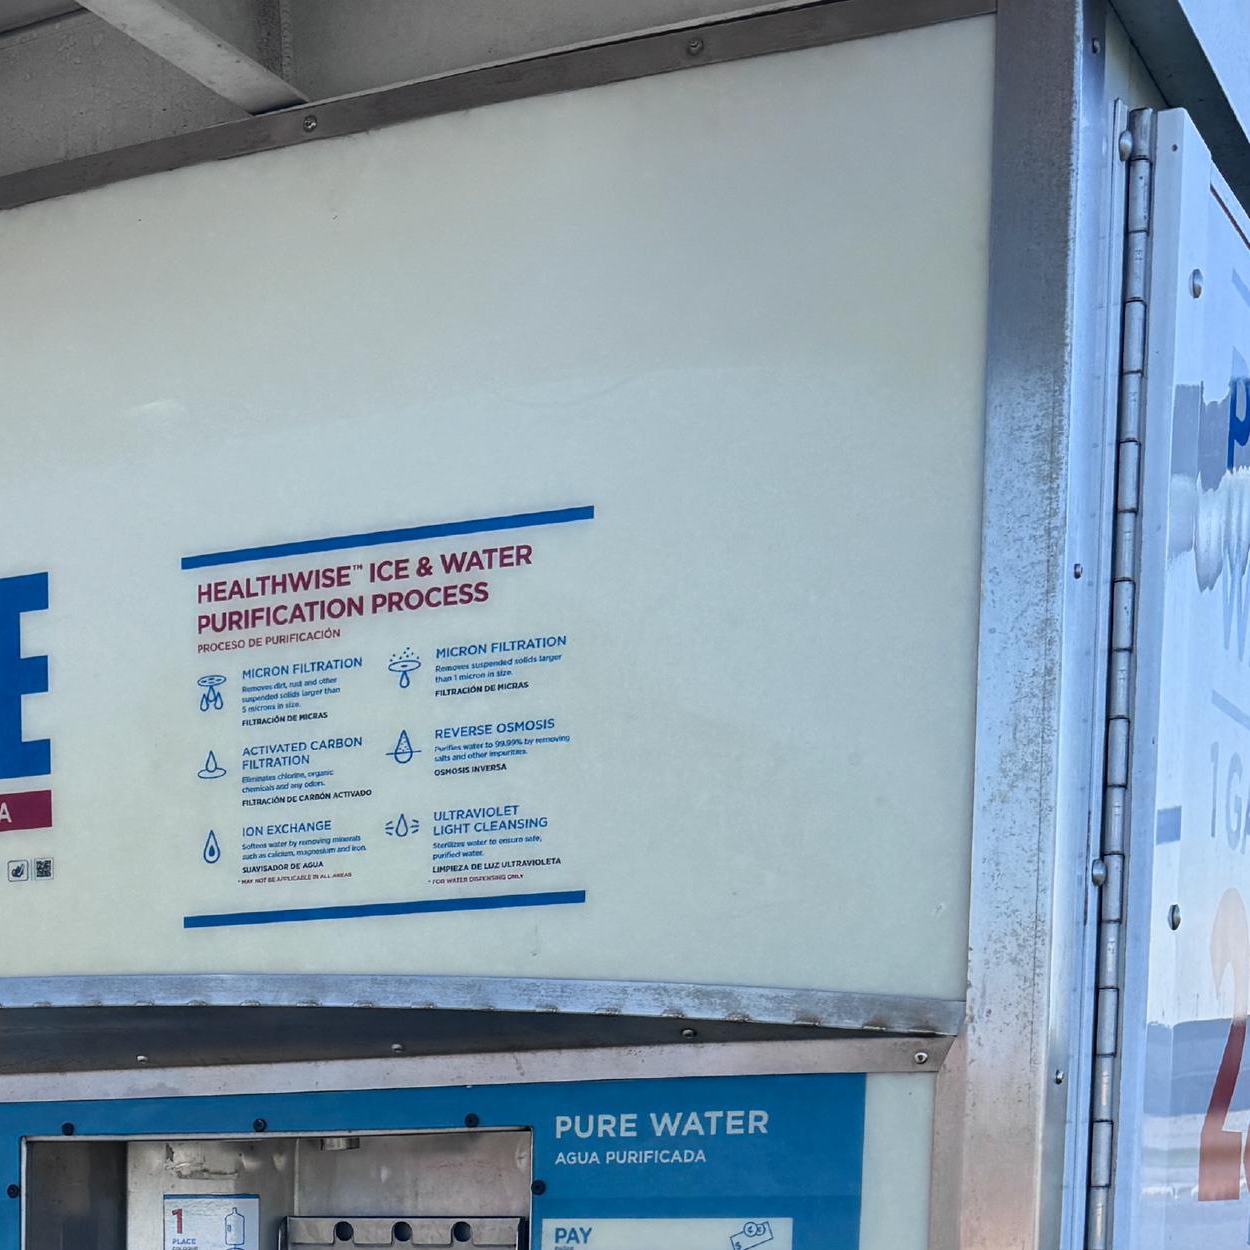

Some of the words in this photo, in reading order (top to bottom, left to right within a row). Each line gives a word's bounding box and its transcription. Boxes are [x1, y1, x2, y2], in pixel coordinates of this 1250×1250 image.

[369, 559, 409, 584] ICE
[416, 556, 433, 577] &
[441, 545, 533, 574] WATER
[198, 596, 364, 634] PURIFICATION
[371, 582, 489, 614] PROCESS
[198, 640, 245, 653] PROCESO
[249, 639, 262, 647] DE
[265, 628, 341, 645] PURIFICACIÓN
[436, 644, 487, 659] MICRON
[491, 636, 566, 653] FILTRATION
[242, 665, 288, 679] MICRON
[293, 657, 362, 674] FILTRATION
[435, 664, 469, 672] Removes
[472, 659, 512, 669] suspended
[515, 656, 537, 664] solids
[539, 654, 562, 663] larger
[435, 675, 451, 683] than
[459, 672, 485, 680] micron
[242, 685, 272, 693] Removes
[289, 680, 302, 688] rust
[435, 686, 482, 697] FILTRACIÓN
[498, 682, 529, 690] MICRAS
[242, 693, 278, 703] suspended
[302, 689, 322, 697] larger
[248, 704, 275, 712] microns
[242, 716, 285, 726] FILTRACIÓN
[299, 712, 328, 720] MICRAS
[435, 724, 492, 739] REVERSE
[497, 719, 555, 733] OSMOSIS
[242, 742, 306, 756] ACTIVATED
[310, 737, 362, 750] CARBON
[242, 755, 309, 770] FILTRATION
[435, 754, 450, 762] salts
[467, 751, 487, 759] other
[489, 749, 527, 757] impurities.
[434, 766, 469, 776] OSMOSIS
[472, 764, 507, 772] INVERSA
[242, 784, 274, 793] chemicals
[291, 782, 303, 790] any
[305, 780, 325, 788] odors.
[242, 796, 285, 806] FILTRACIÓN
[299, 791, 330, 802] CARBÓN
[333, 790, 372, 799] ACTIVADO
[434, 805, 519, 821] ULTRAVIOLET
[243, 827, 263, 837] ION
[267, 821, 331, 835] EXCHANGE
[434, 823, 470, 836] LIGHT
[474, 817, 548, 832] CLEANSING
[433, 852, 460, 860] purified
[433, 863, 468, 873] LIMPIEZA
[502, 858, 561, 868] ULTRAVIOLETA
[556, 1114, 637, 1139] PURE
[650, 1111, 768, 1136] WATER
[555, 1152, 600, 1165] AGUA
[606, 1150, 706, 1164] PURIFICADA
[172, 1209, 183, 1234] 1
[555, 1228, 592, 1244] PAY
